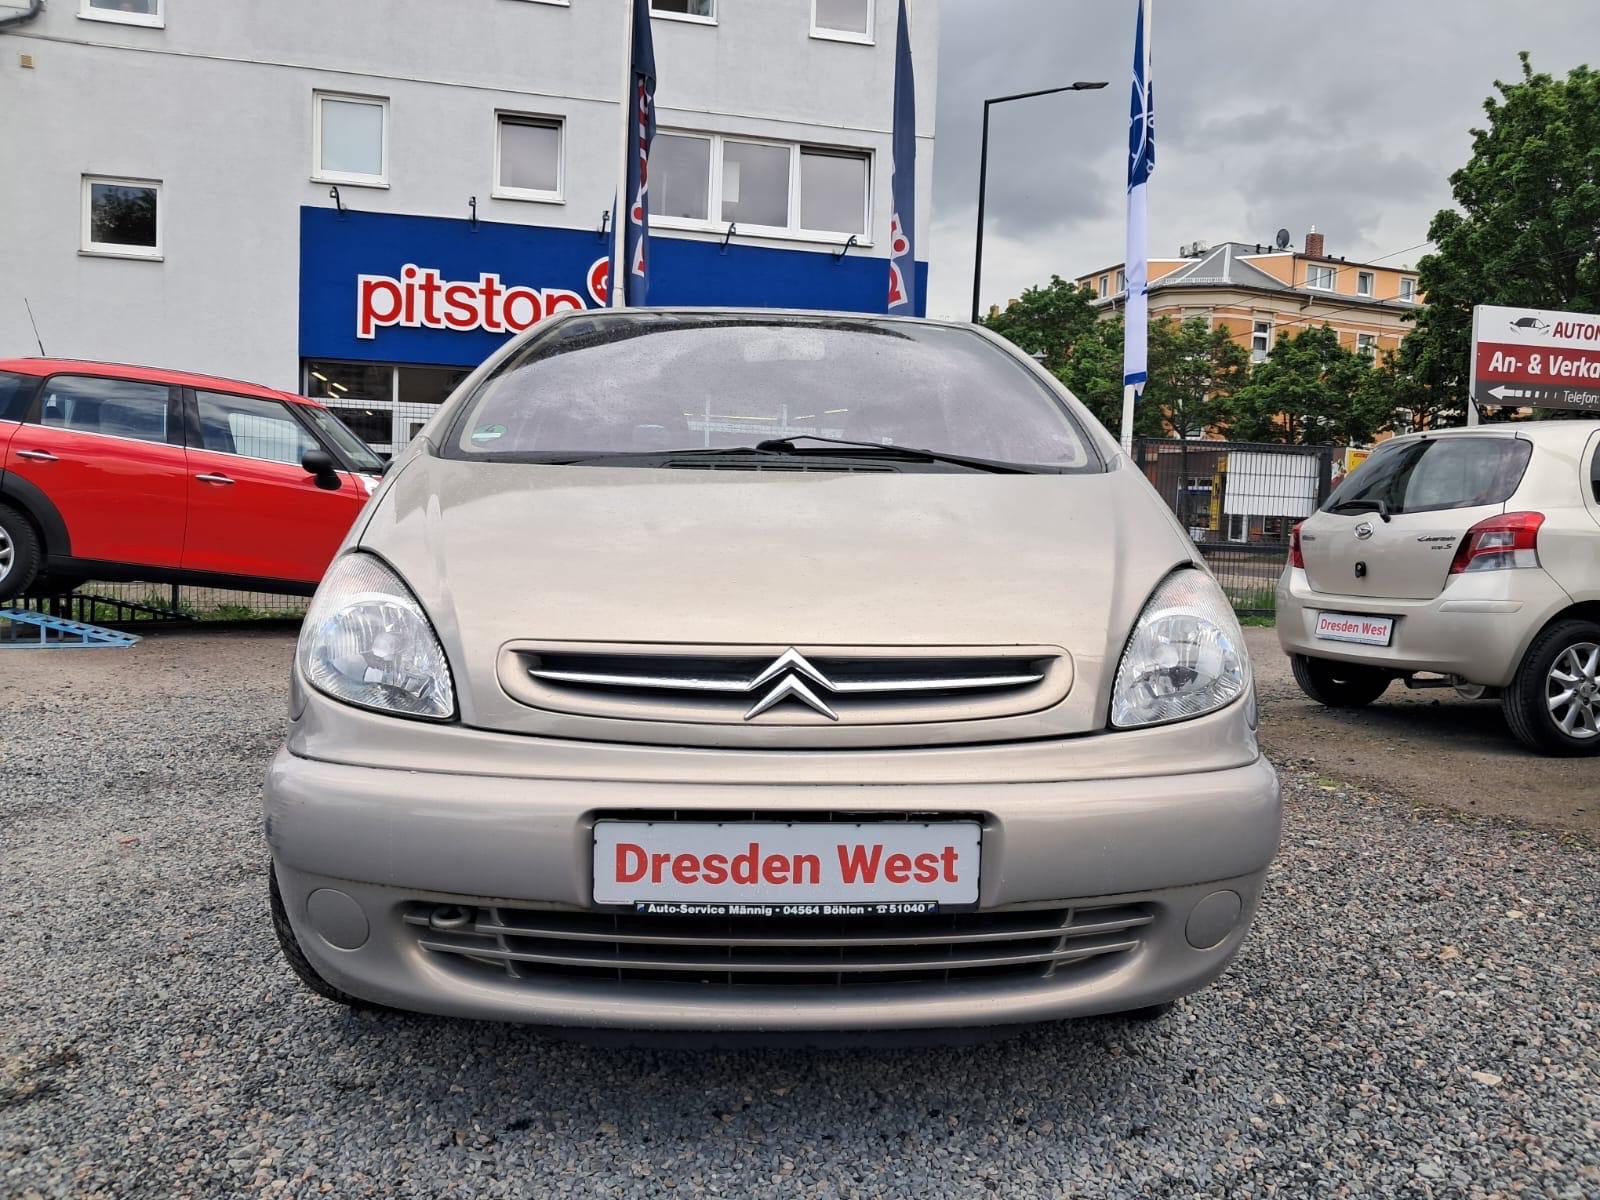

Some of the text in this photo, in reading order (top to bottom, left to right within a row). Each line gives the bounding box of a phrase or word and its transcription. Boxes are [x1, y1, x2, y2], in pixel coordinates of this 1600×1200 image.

[1488, 350, 1523, 374] An-
[1527, 353, 1542, 375] &
[1320, 618, 1387, 637] Dresden West
[615, 841, 959, 885] Dresden West
[648, 903, 926, 917] Auto-Service Männig 04564 Böhlen 51040
